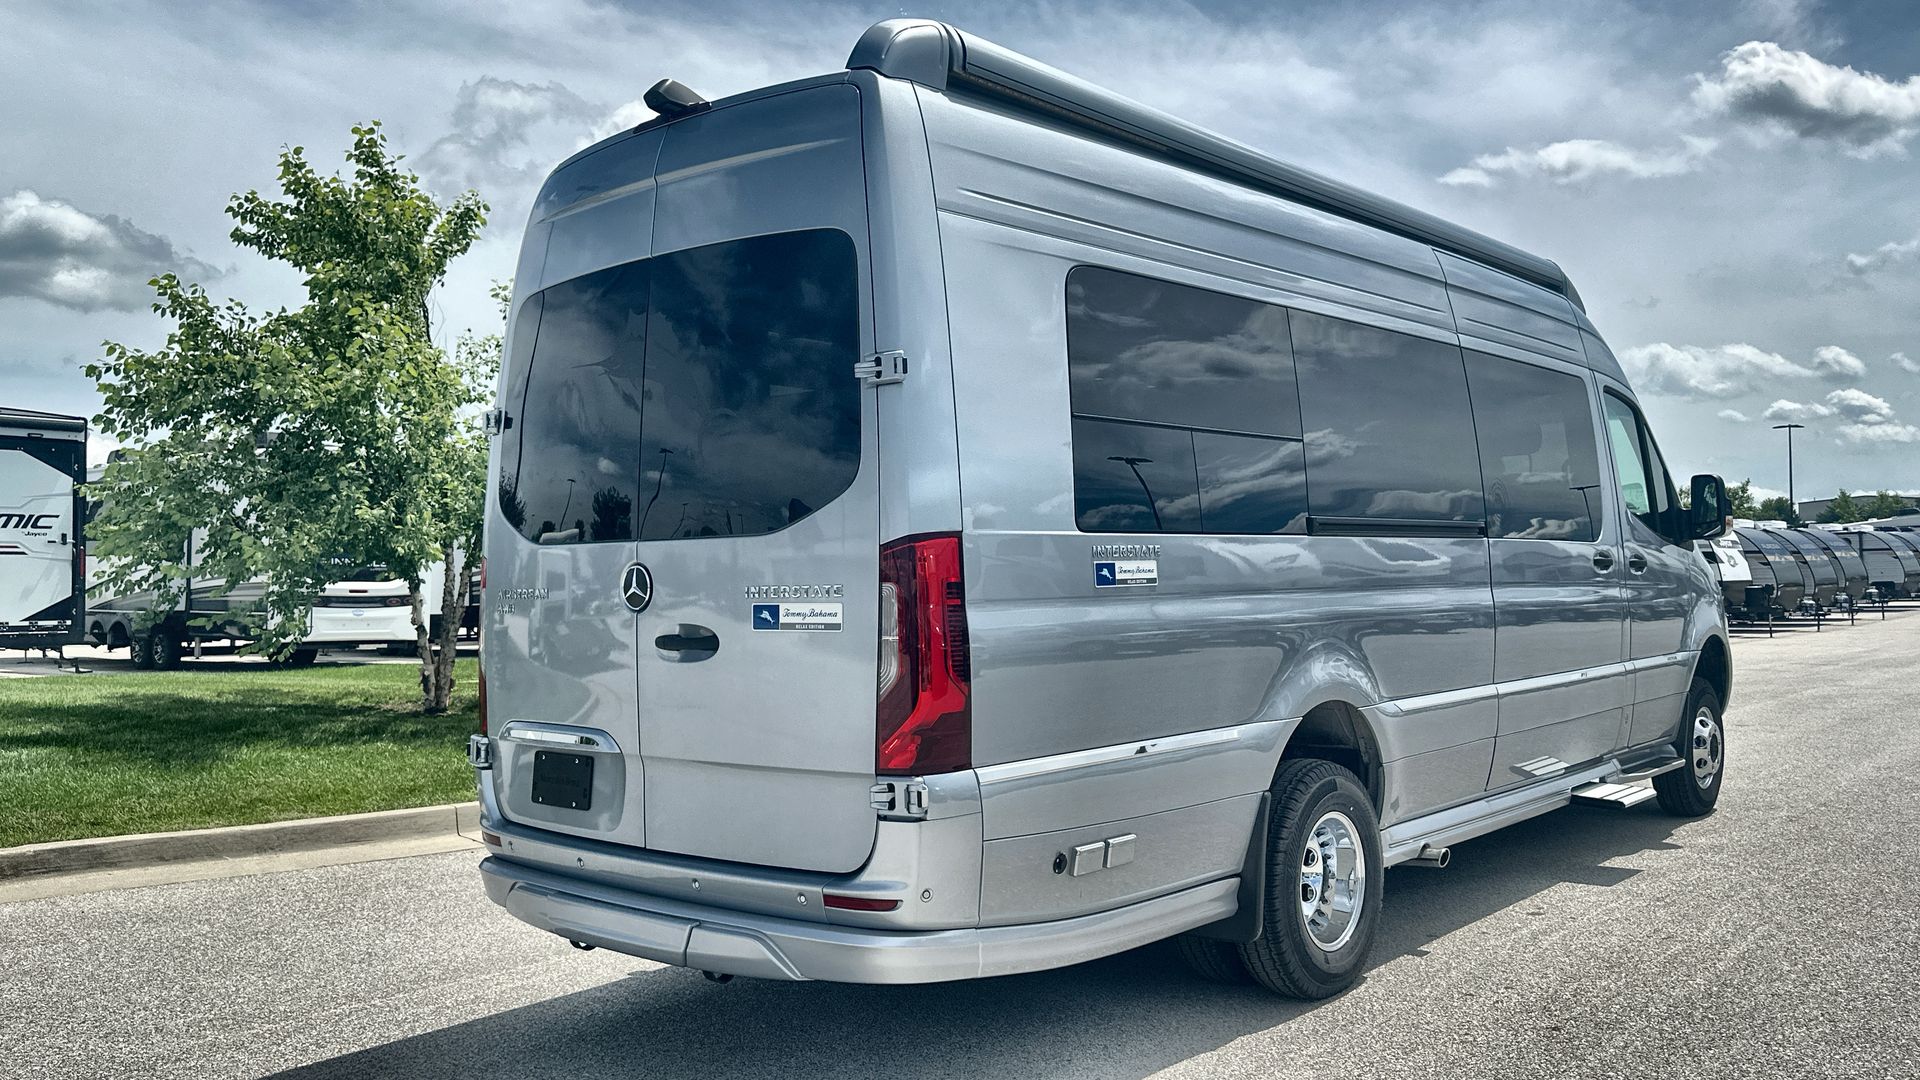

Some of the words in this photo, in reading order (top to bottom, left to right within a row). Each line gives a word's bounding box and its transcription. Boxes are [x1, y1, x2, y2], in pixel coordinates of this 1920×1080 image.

[1092, 544, 1161, 558] INTERSTATE
[744, 584, 844, 599] INTERSTATE
[783, 608, 807, 621] Tommy
[808, 608, 838, 618] Bahama
